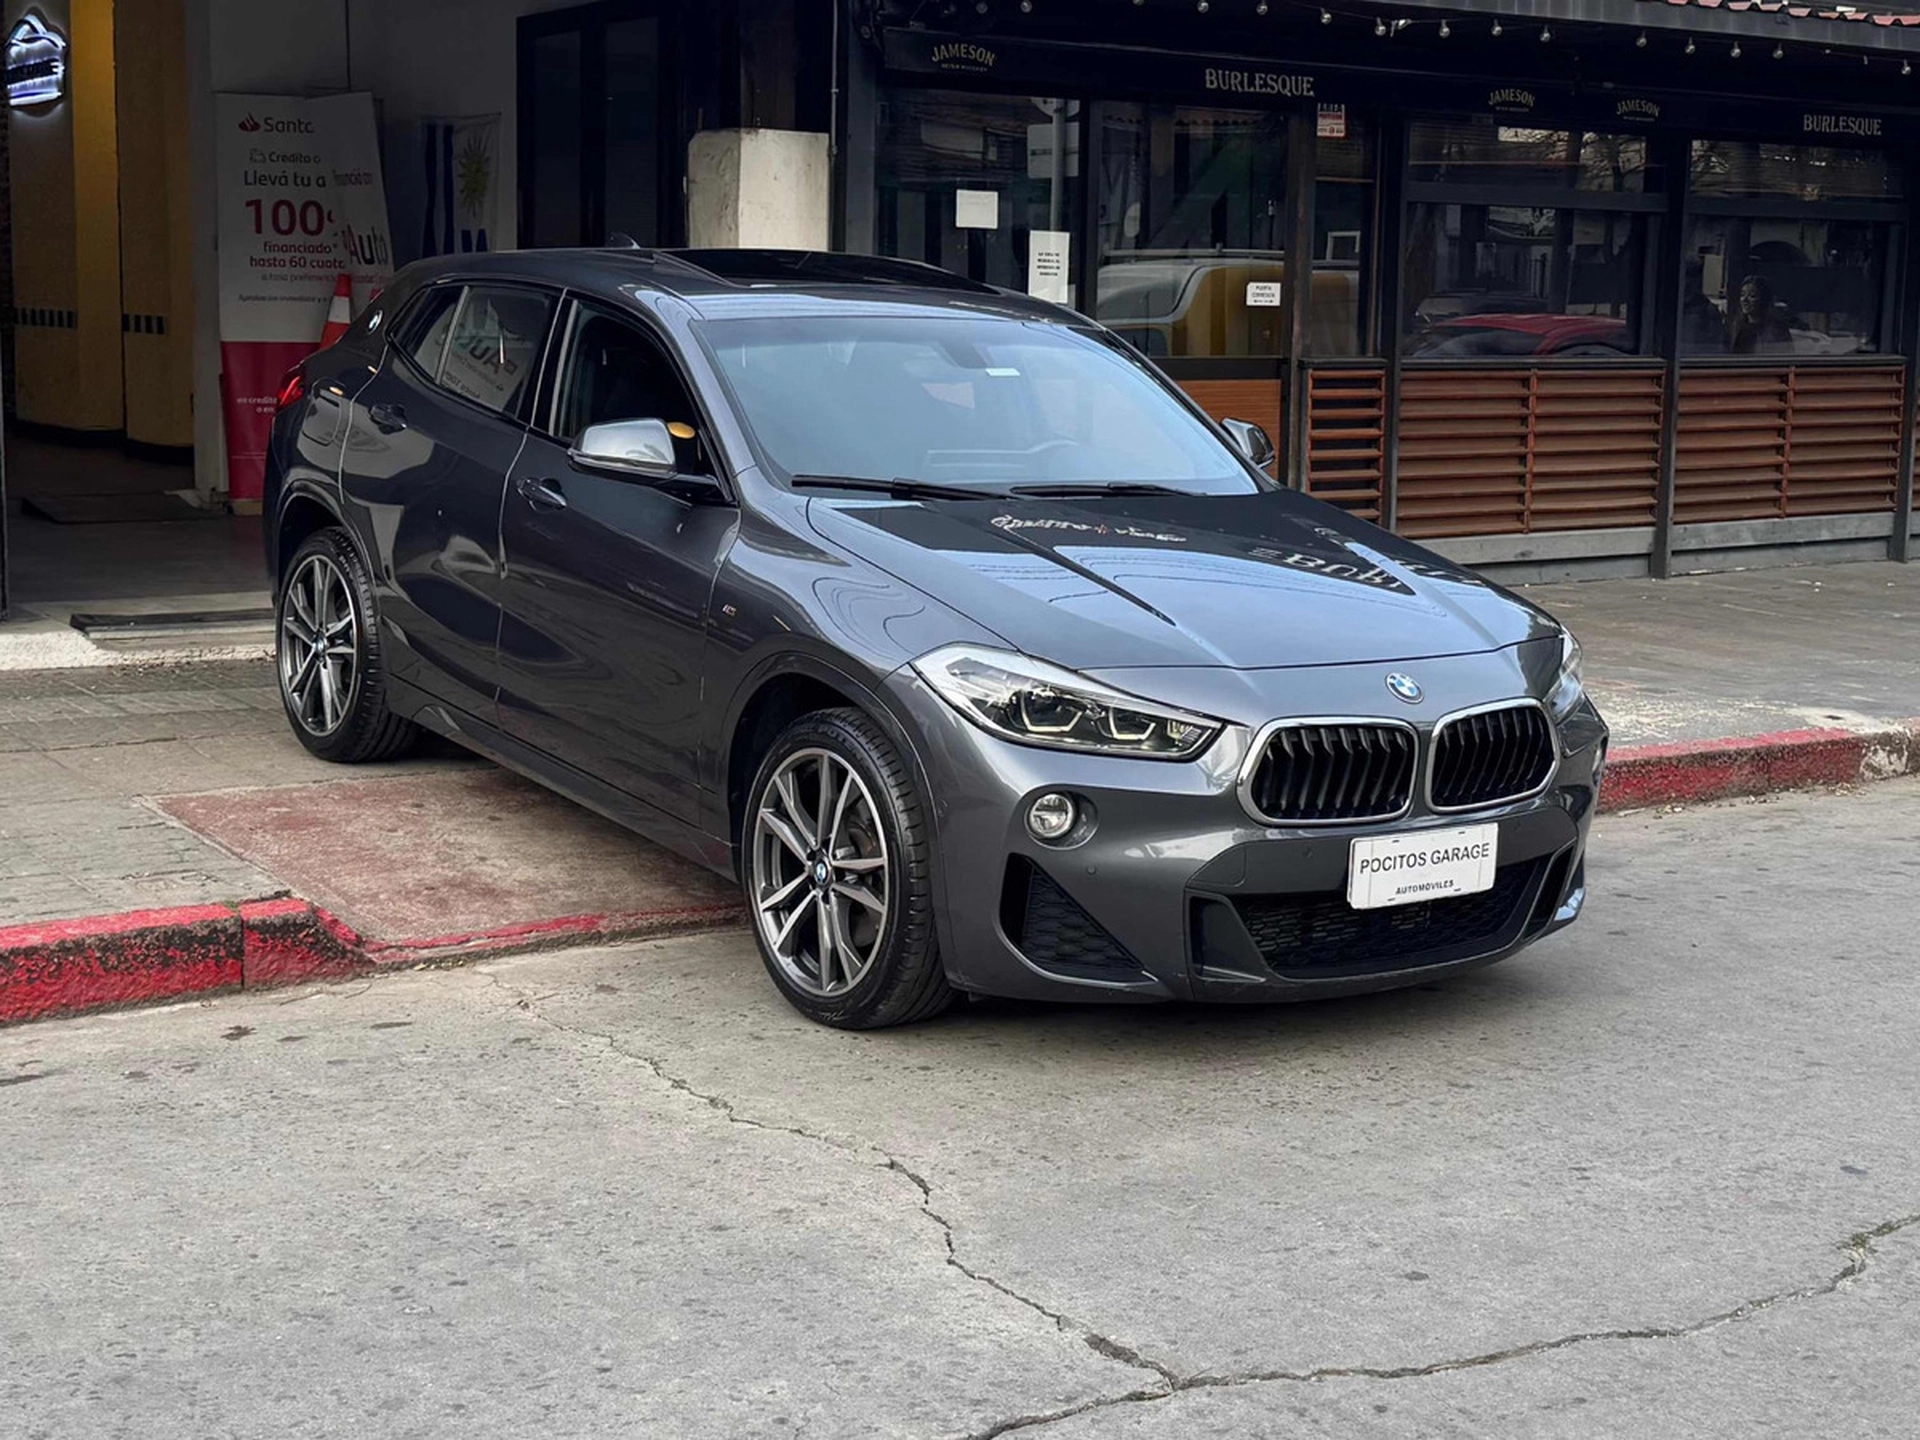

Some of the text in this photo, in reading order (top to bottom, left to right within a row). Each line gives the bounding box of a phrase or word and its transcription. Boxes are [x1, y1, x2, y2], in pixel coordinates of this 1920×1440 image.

[931, 42, 996, 67] JAMESON
[1205, 67, 1315, 97] BURLESQUE
[1487, 88, 1535, 108] JAMESON
[1615, 99, 1660, 118] JAMESON
[1803, 113, 1882, 136] BURLESQUE
[244, 169, 289, 186] Llevá
[293, 171, 311, 187] tu
[250, 256, 286, 269] hasta
[289, 257, 307, 269] 60
[1360, 842, 1490, 875] POCITOS GARAGE
